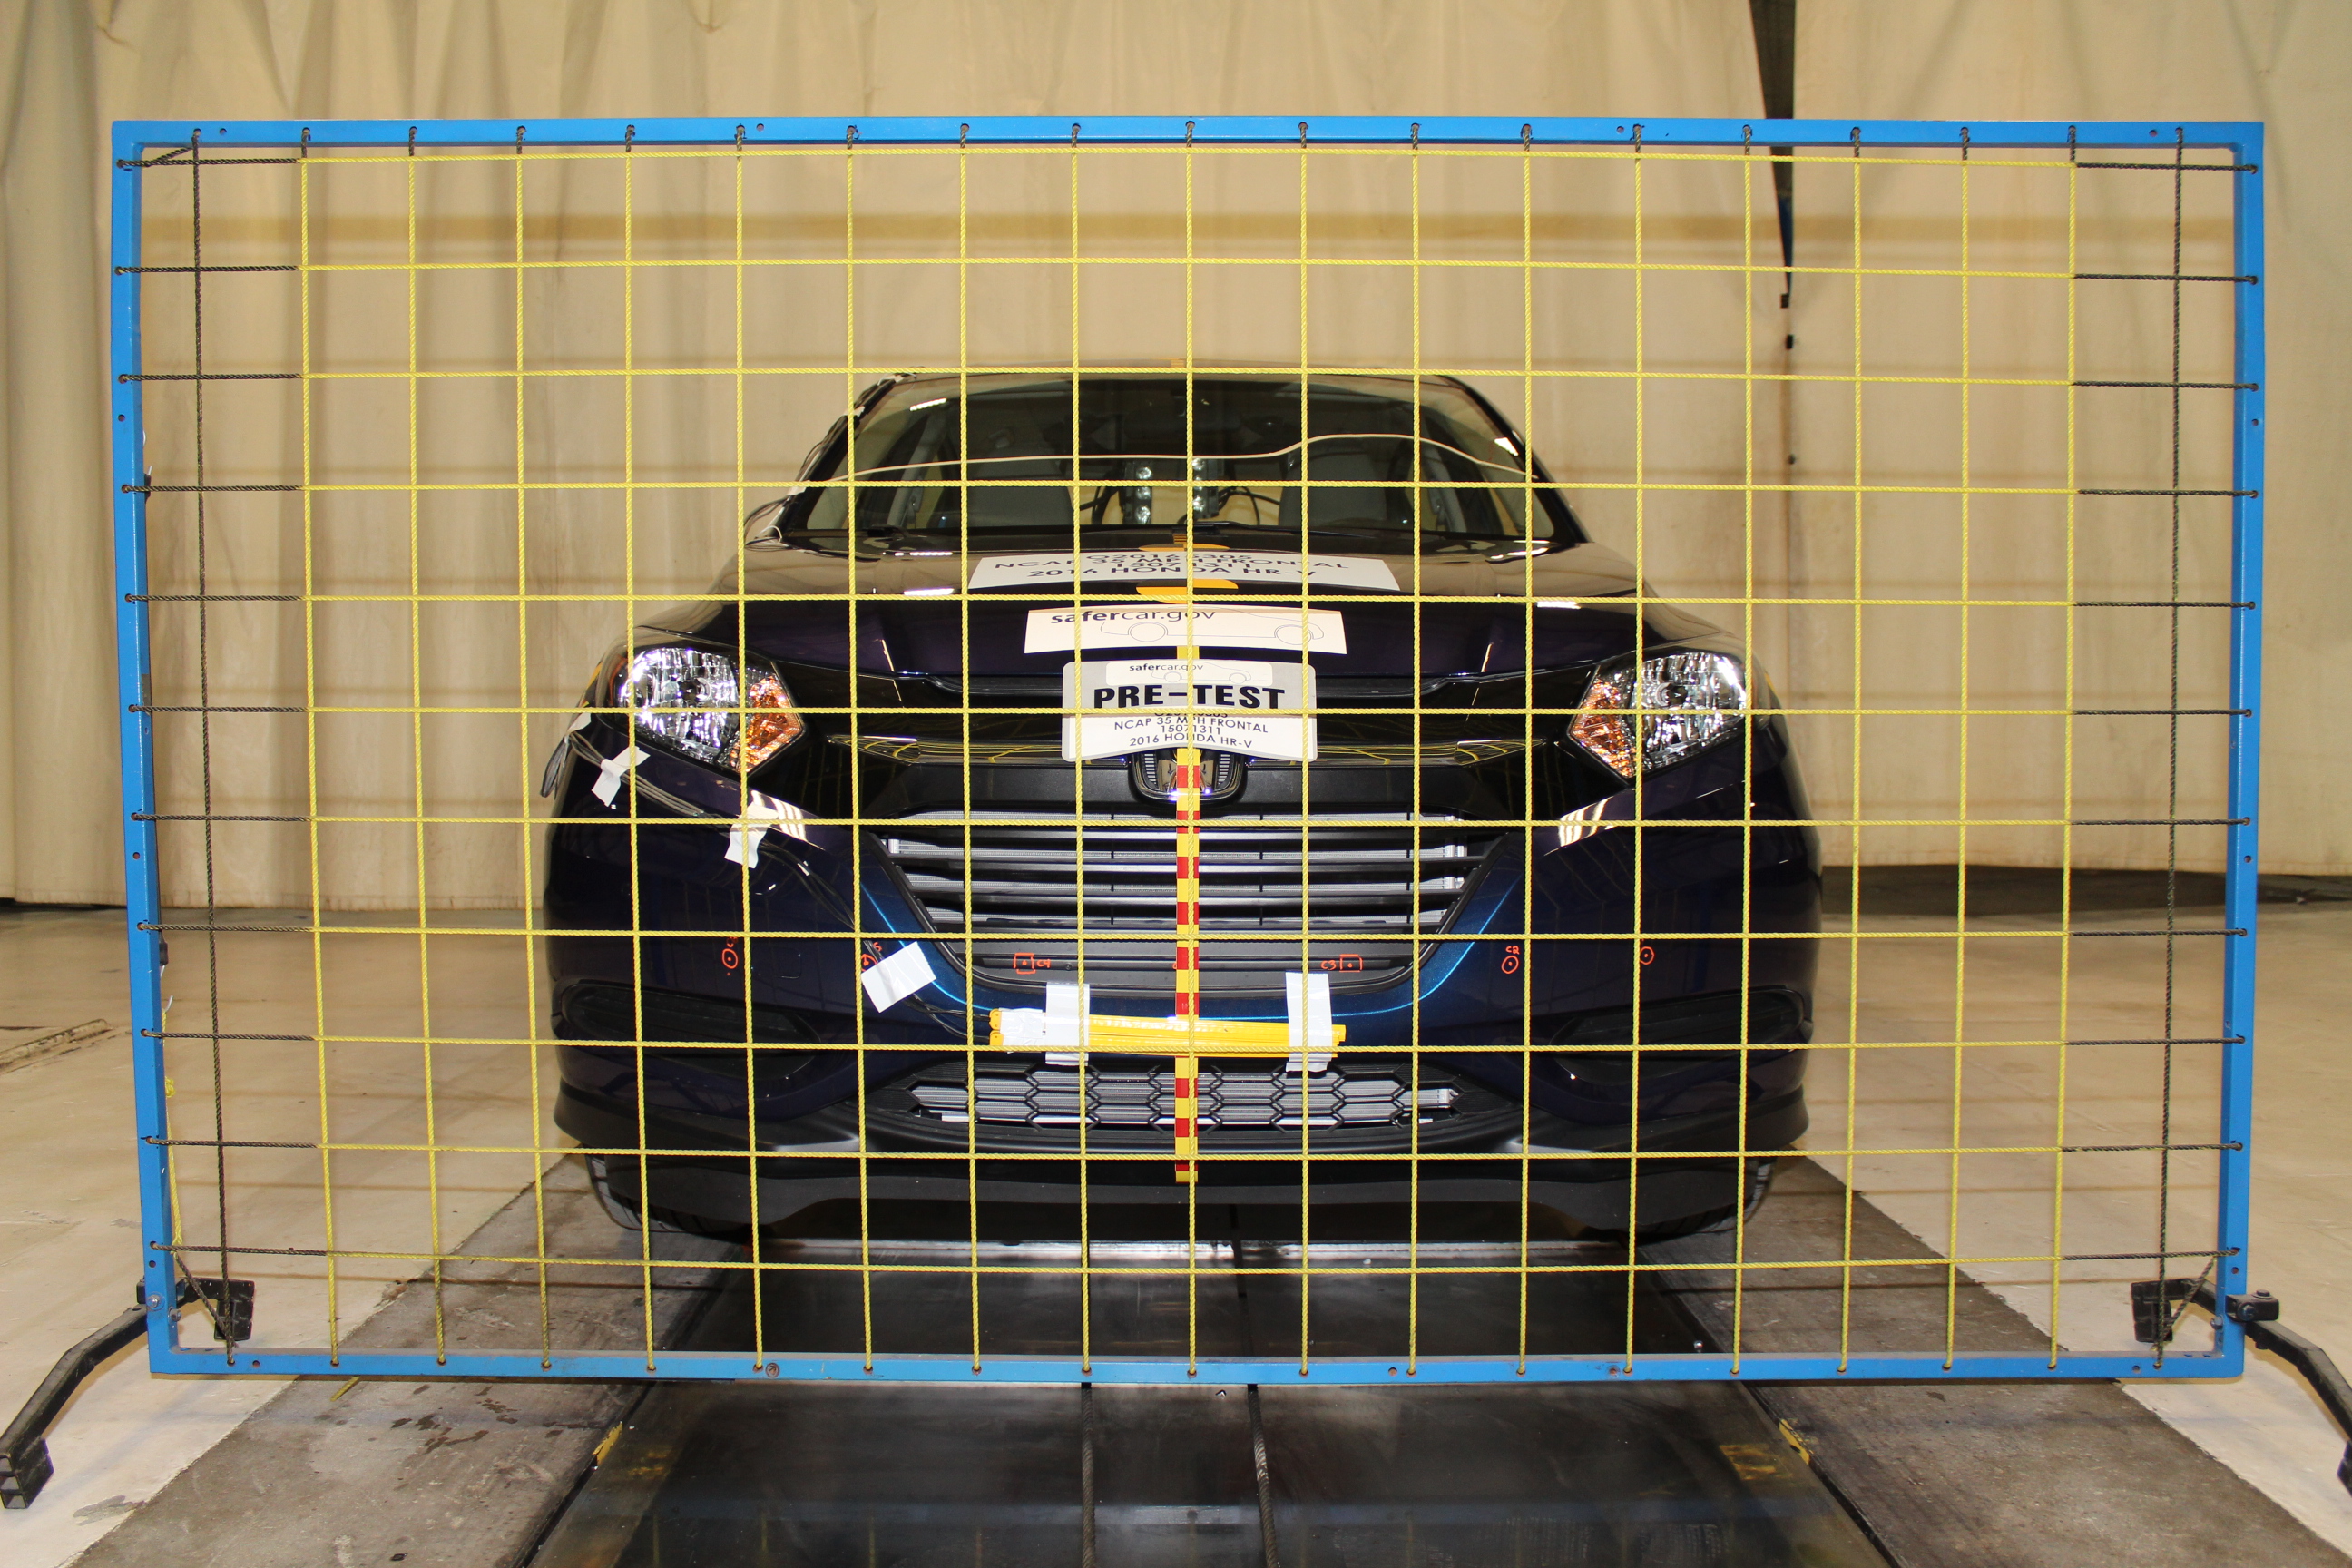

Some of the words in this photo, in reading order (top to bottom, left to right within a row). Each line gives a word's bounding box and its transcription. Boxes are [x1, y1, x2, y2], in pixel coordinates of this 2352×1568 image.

[995, 560, 1078, 569] NCAP
[1027, 568, 1098, 578] 2016
[1242, 568, 1316, 577] HR-V
[1051, 610, 1216, 624] safercar.gov
[1129, 663, 1204, 671] safercar.gov
[1093, 684, 1285, 709] PRE-TEST
[1114, 718, 1152, 730] NCAP
[1156, 717, 1171, 725] 35
[1210, 718, 1269, 733] FRONTAL
[1161, 725, 1220, 735] 15071311
[1129, 735, 1160, 747] 2016
[1164, 732, 1216, 743] HONDA
[1220, 736, 1252, 748] HR-V
[1505, 945, 1520, 955] C2
[1320, 959, 1337, 971] C3
